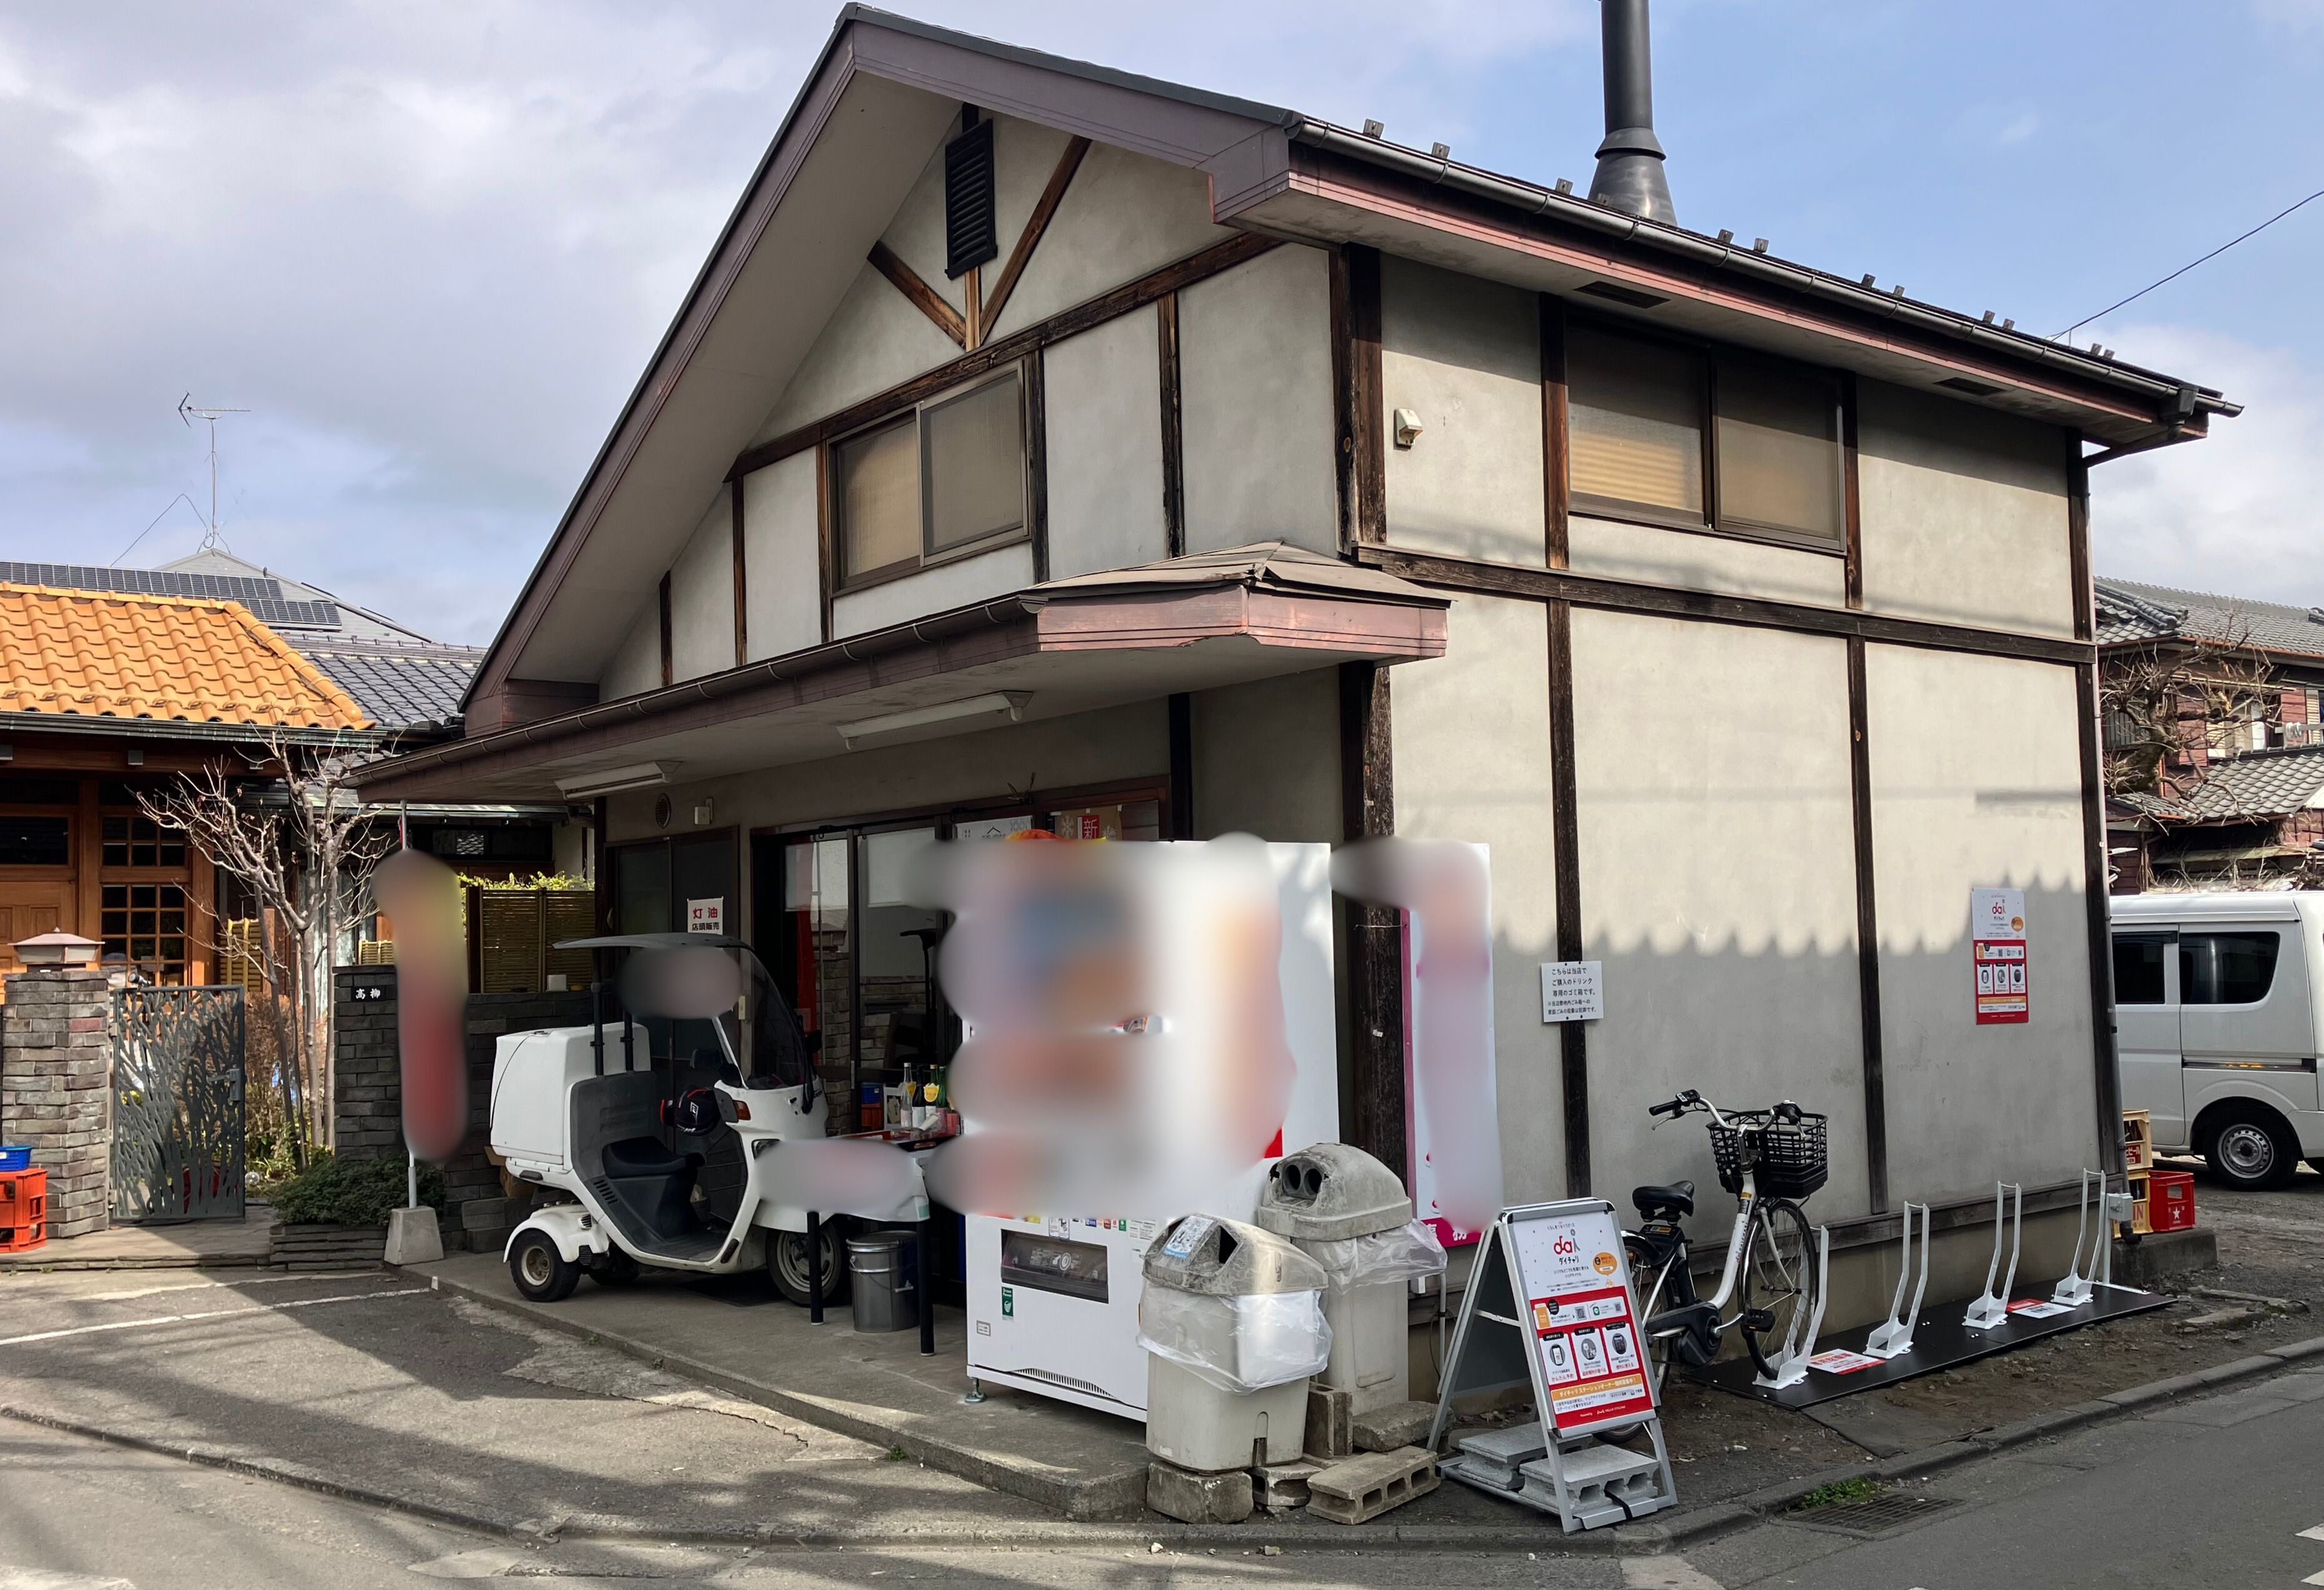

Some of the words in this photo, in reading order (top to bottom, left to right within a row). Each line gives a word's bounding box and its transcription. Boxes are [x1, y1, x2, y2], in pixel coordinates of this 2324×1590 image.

[692, 907, 718, 920] 灯油
[691, 922, 720, 931] 店頭販売
[1552, 977, 1593, 986] ご購入のドリンク
[1553, 1229, 1580, 1255] dai
[1559, 1256, 1579, 1265] ダイチャリ
